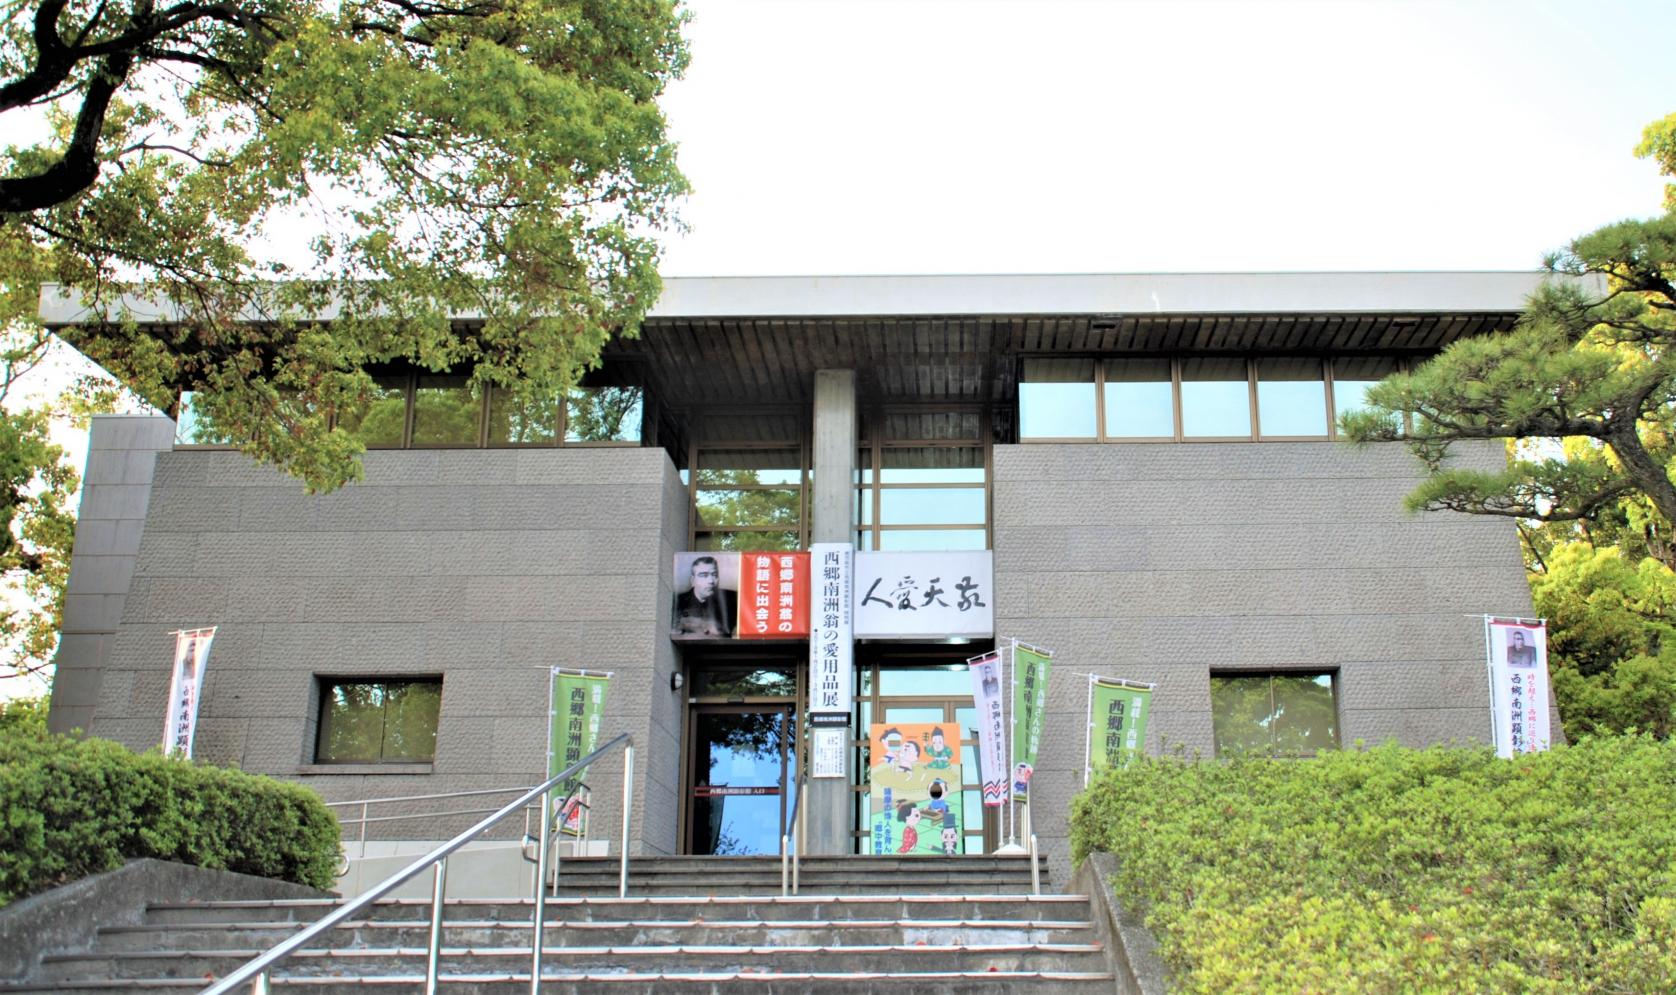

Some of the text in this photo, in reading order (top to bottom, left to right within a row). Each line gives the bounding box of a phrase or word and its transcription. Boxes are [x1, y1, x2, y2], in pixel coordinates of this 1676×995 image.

[756, 556, 770, 633] 物語に出会う
[779, 556, 793, 632] 西郷南洲翁の
[822, 551, 840, 707] 西郷南洲翁の愛用品展
